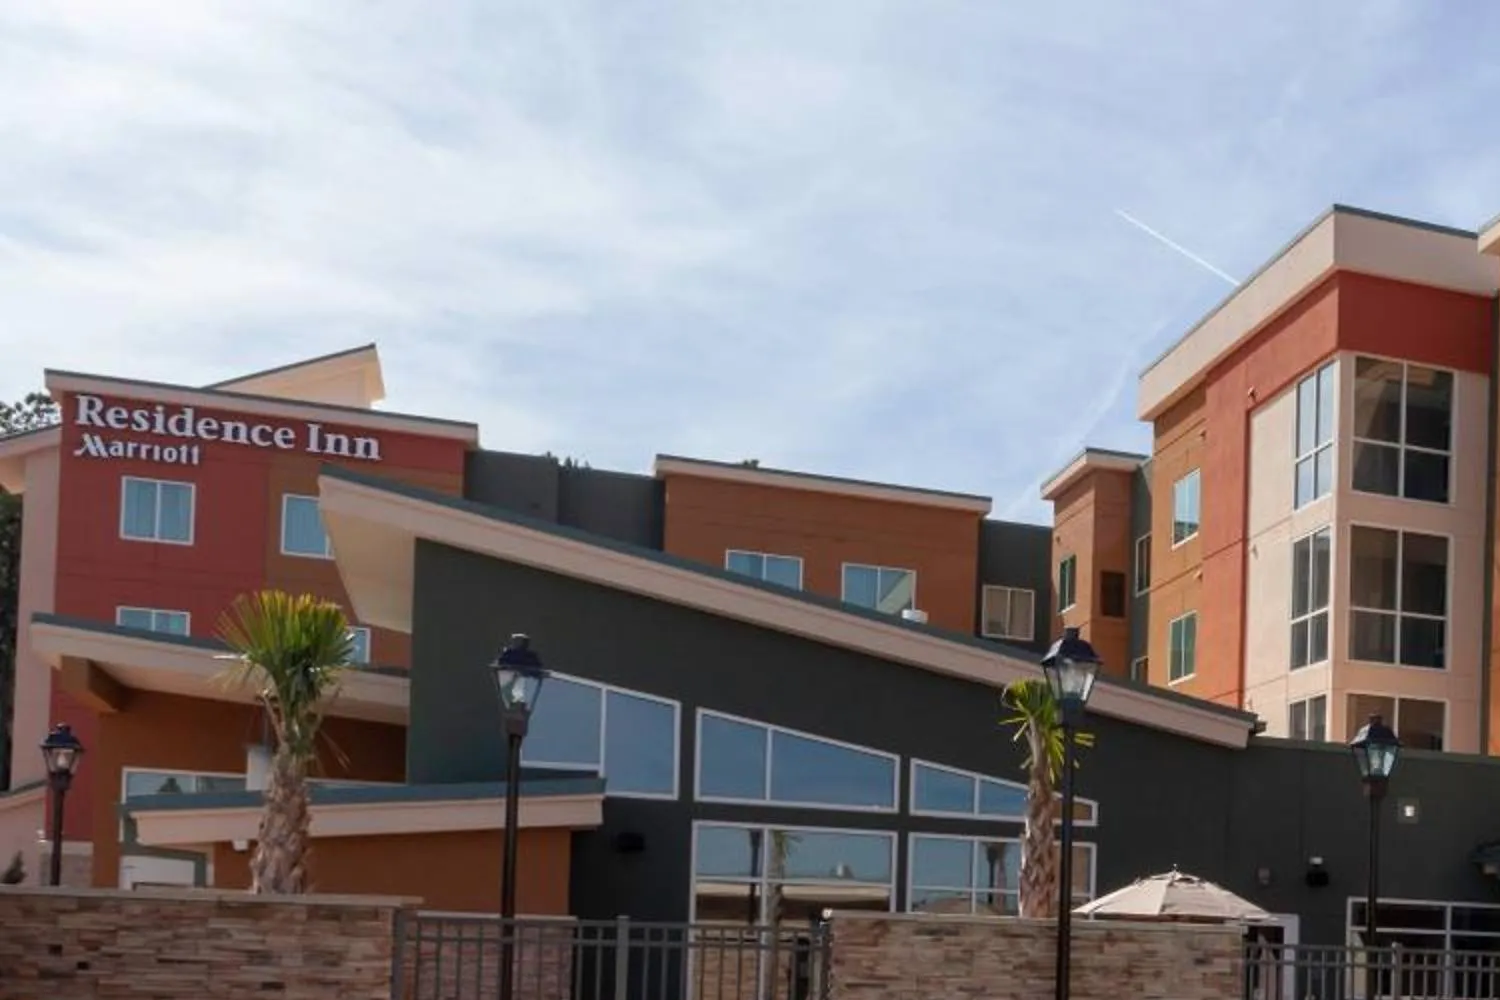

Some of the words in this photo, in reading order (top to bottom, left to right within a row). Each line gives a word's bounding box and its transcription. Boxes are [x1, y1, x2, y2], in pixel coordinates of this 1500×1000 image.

[74, 433, 200, 466] Marriott
[75, 395, 296, 449] Residence
[305, 421, 383, 461] Inn
